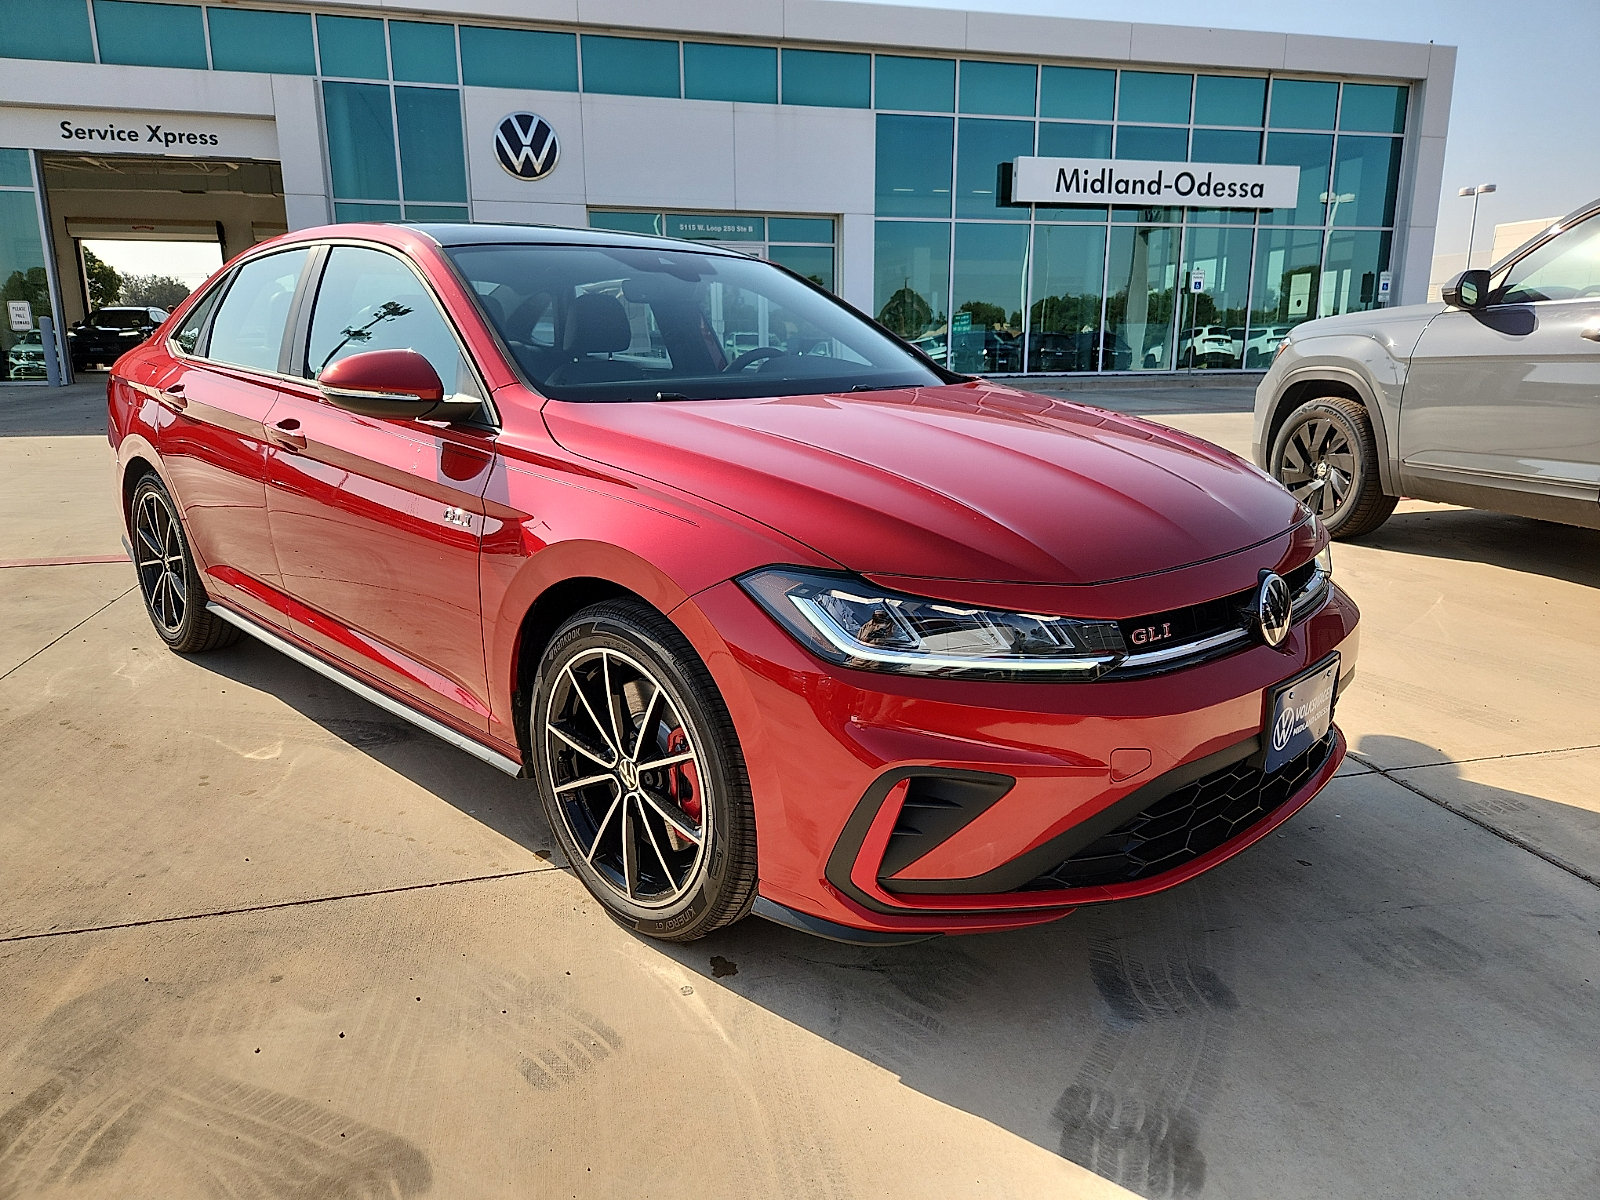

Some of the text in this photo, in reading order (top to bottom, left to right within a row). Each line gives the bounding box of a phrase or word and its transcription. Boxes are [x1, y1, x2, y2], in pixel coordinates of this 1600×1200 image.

[60, 120, 219, 147] Service Xpress
[1055, 167, 1265, 198] Midland-Odessa
[679, 223, 696, 231] 5115
[706, 224, 722, 232] Loop
[736, 225, 747, 233] Ste
[1131, 622, 1172, 644] GLI
